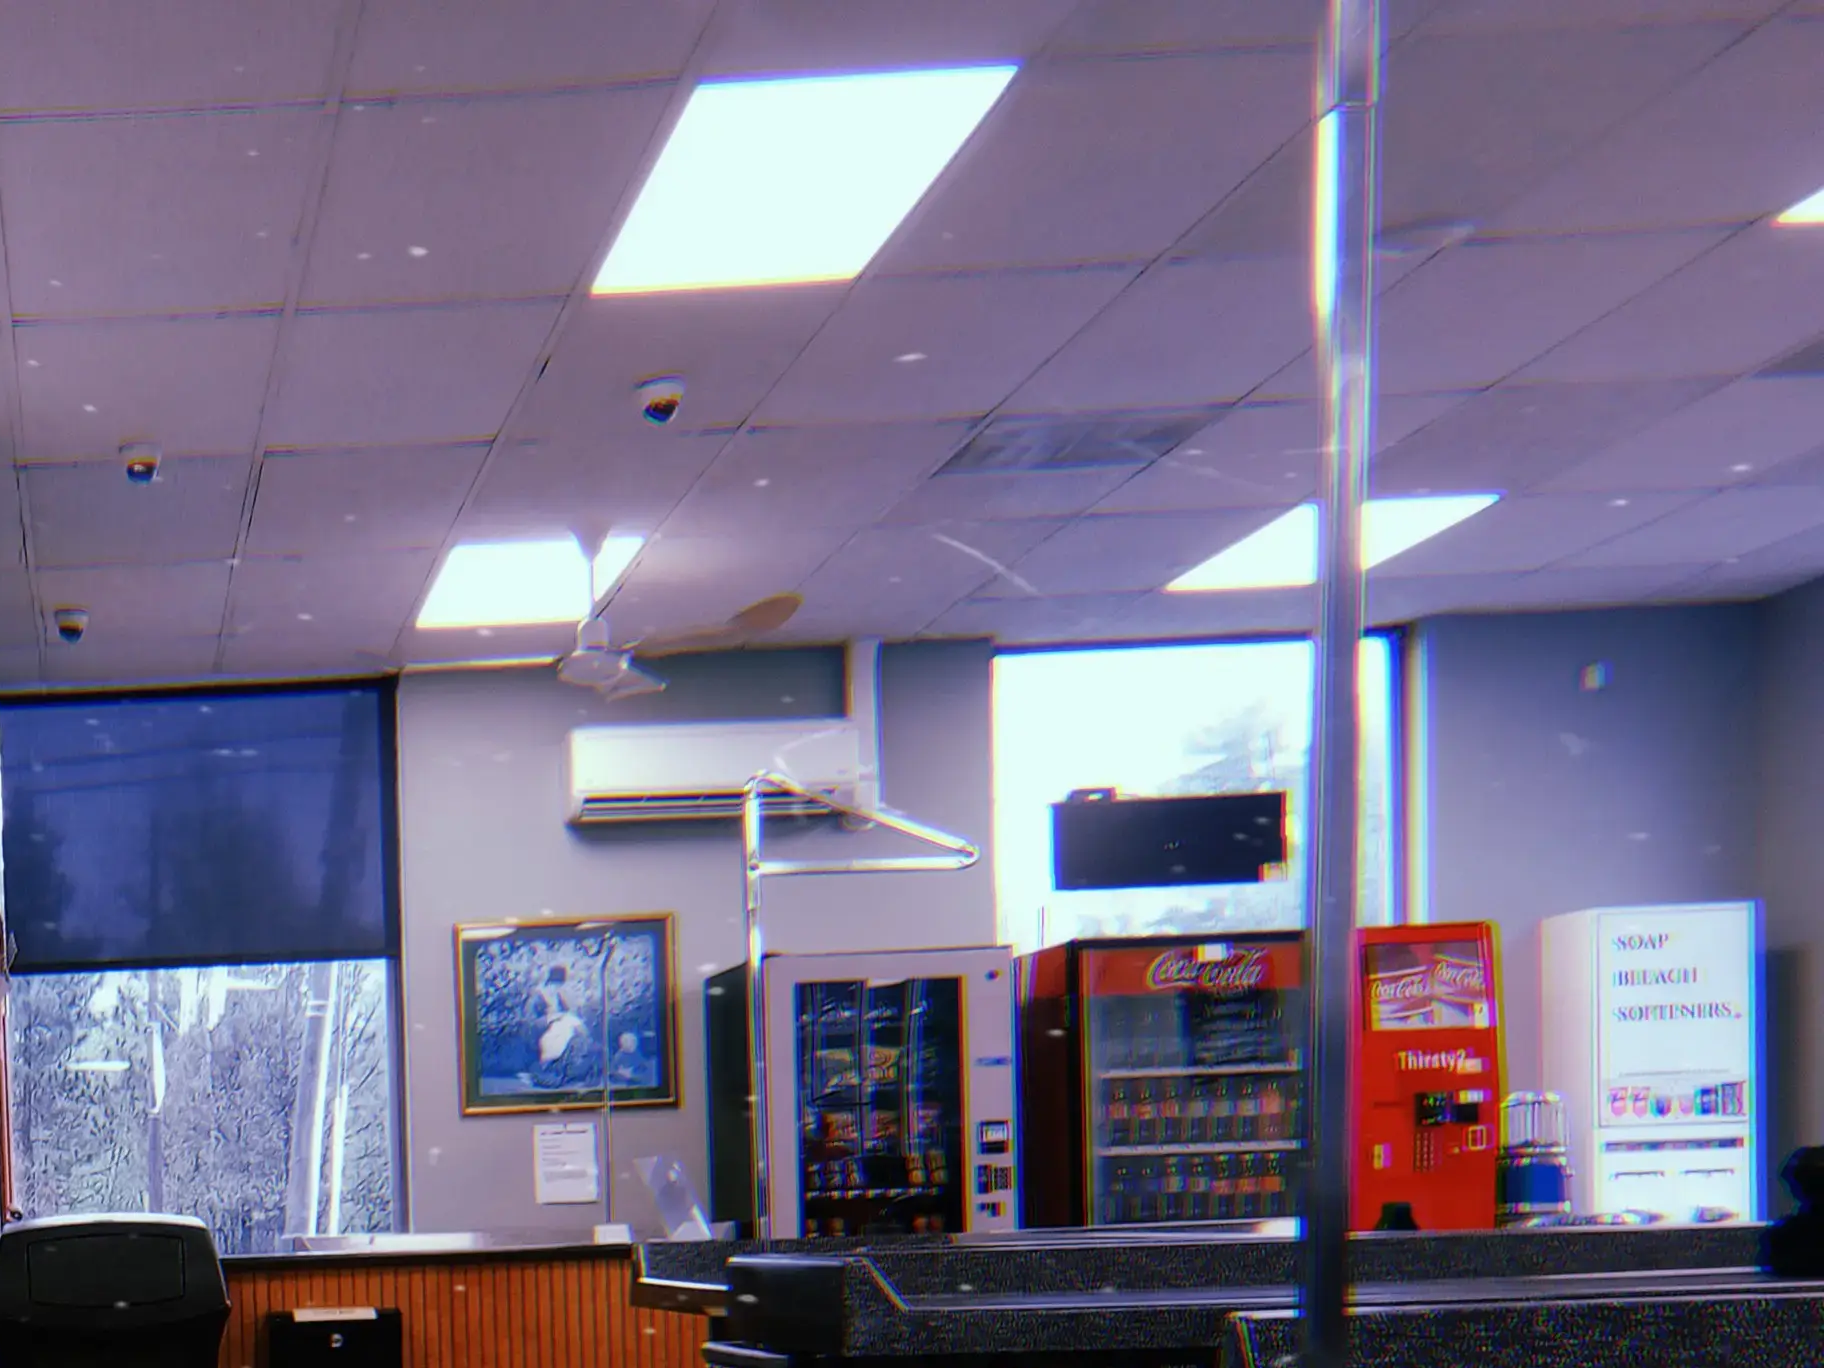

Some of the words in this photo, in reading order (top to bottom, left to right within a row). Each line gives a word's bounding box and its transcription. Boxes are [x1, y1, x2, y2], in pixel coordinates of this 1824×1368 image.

[1613, 933, 1670, 951] SOAP
[1613, 966, 1699, 986] BLEACH
[1397, 1048, 1466, 1072] Thirsty?
